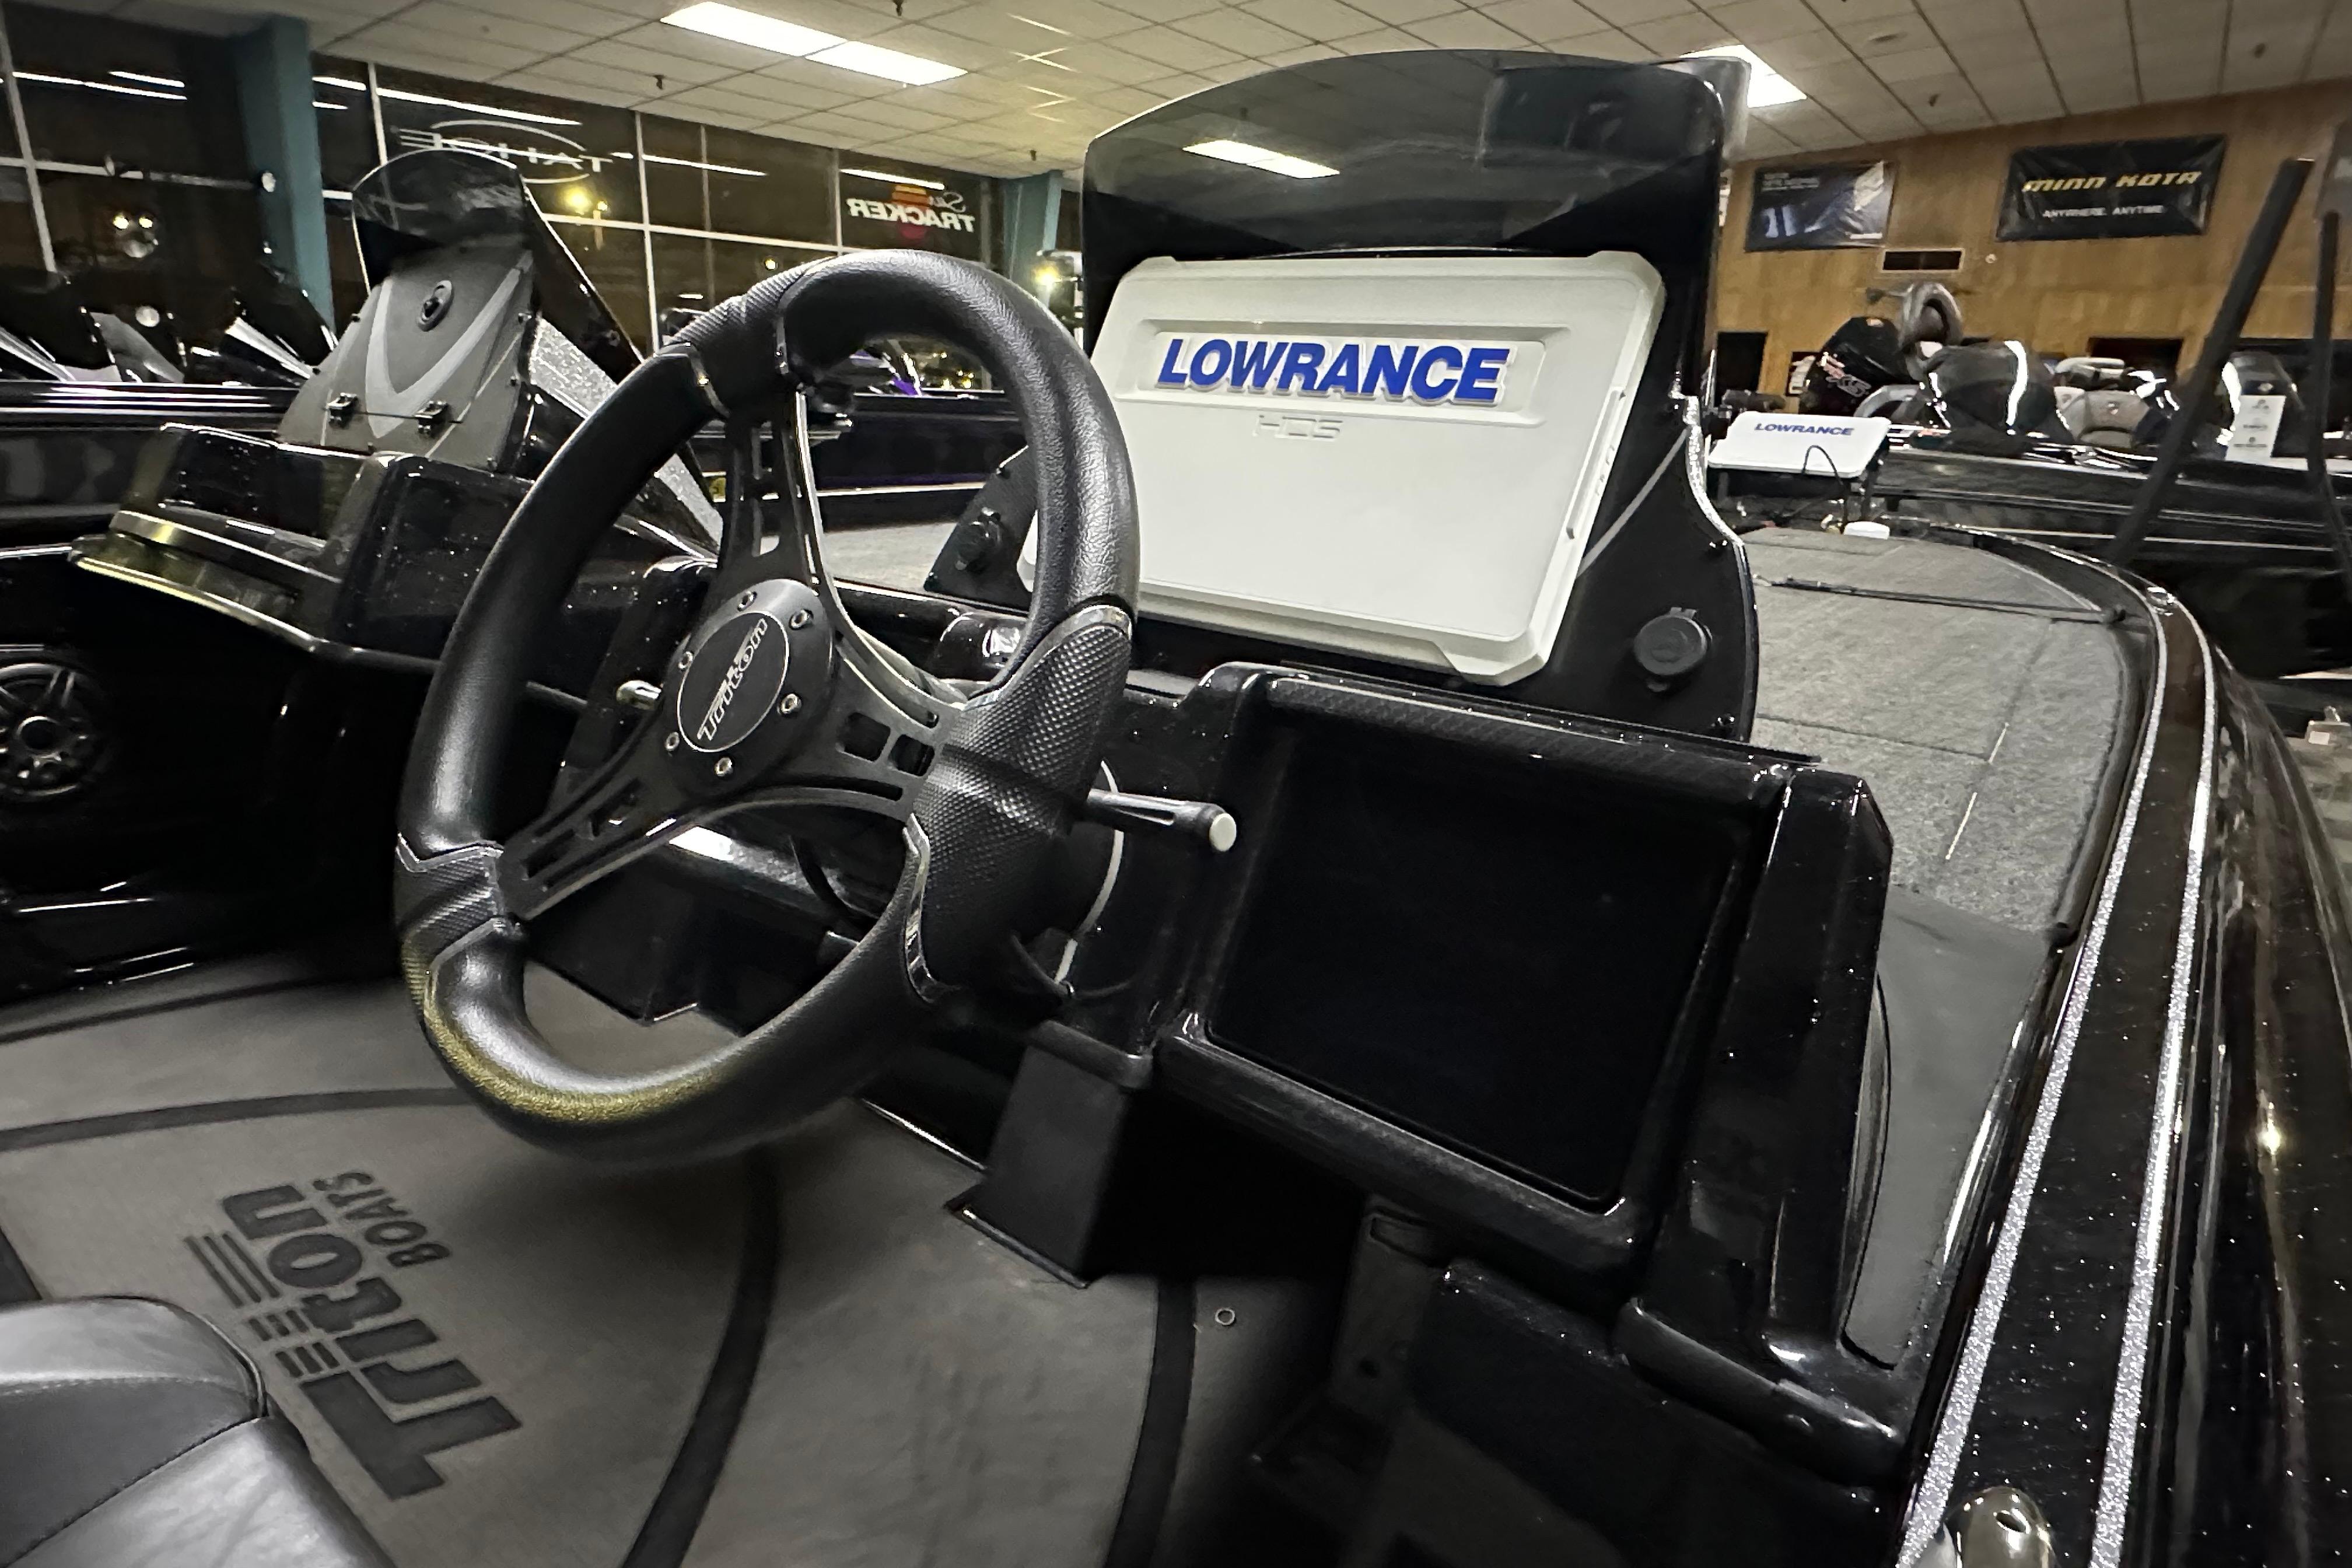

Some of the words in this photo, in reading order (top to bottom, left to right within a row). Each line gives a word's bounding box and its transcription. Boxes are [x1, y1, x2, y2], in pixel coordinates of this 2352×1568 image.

[2115, 171, 2203, 187] KOTA
[1157, 338, 1511, 404] LOWRANCE
[1252, 414, 1343, 441] HDS
[1754, 423, 1854, 436] LOWRANCE
[312, 1171, 452, 1268] BOATS
